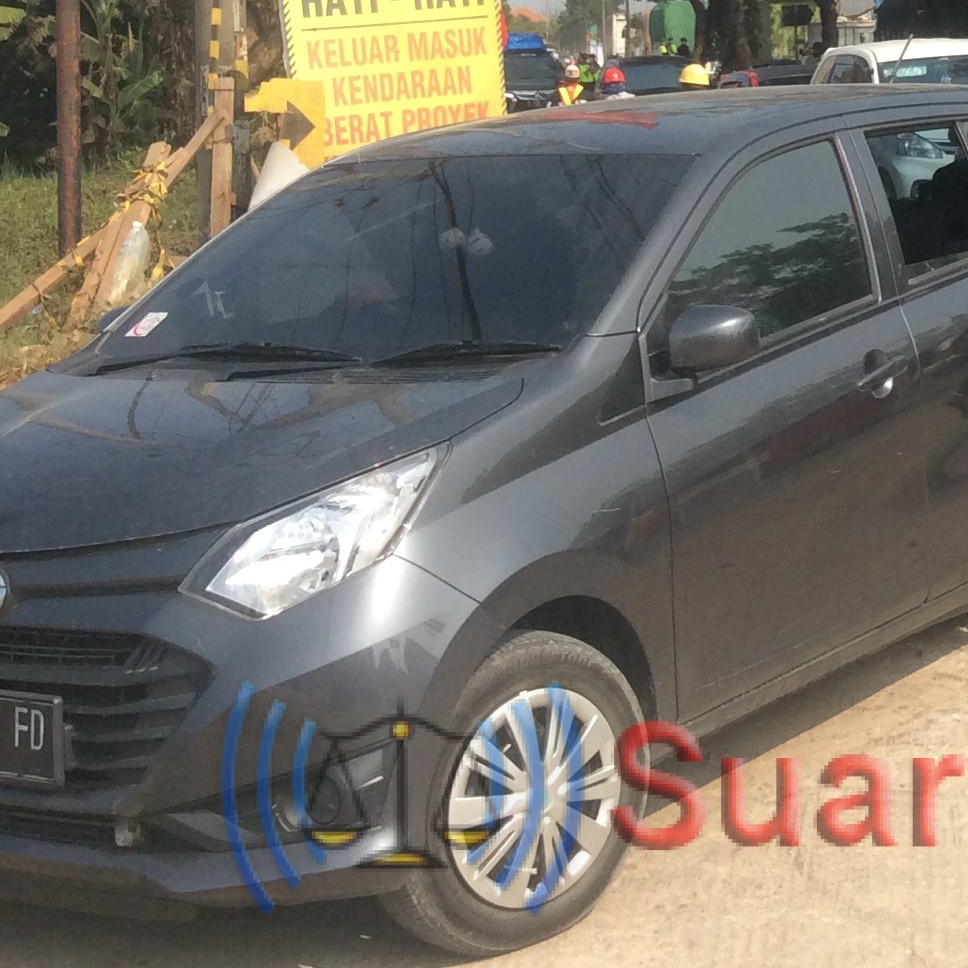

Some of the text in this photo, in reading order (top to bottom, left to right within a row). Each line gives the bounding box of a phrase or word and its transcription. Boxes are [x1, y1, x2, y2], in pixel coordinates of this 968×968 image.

[306, 26, 488, 70] KELUAR MASUK
[332, 65, 473, 107] KENDARAAN
[14, 706, 45, 751] FD
